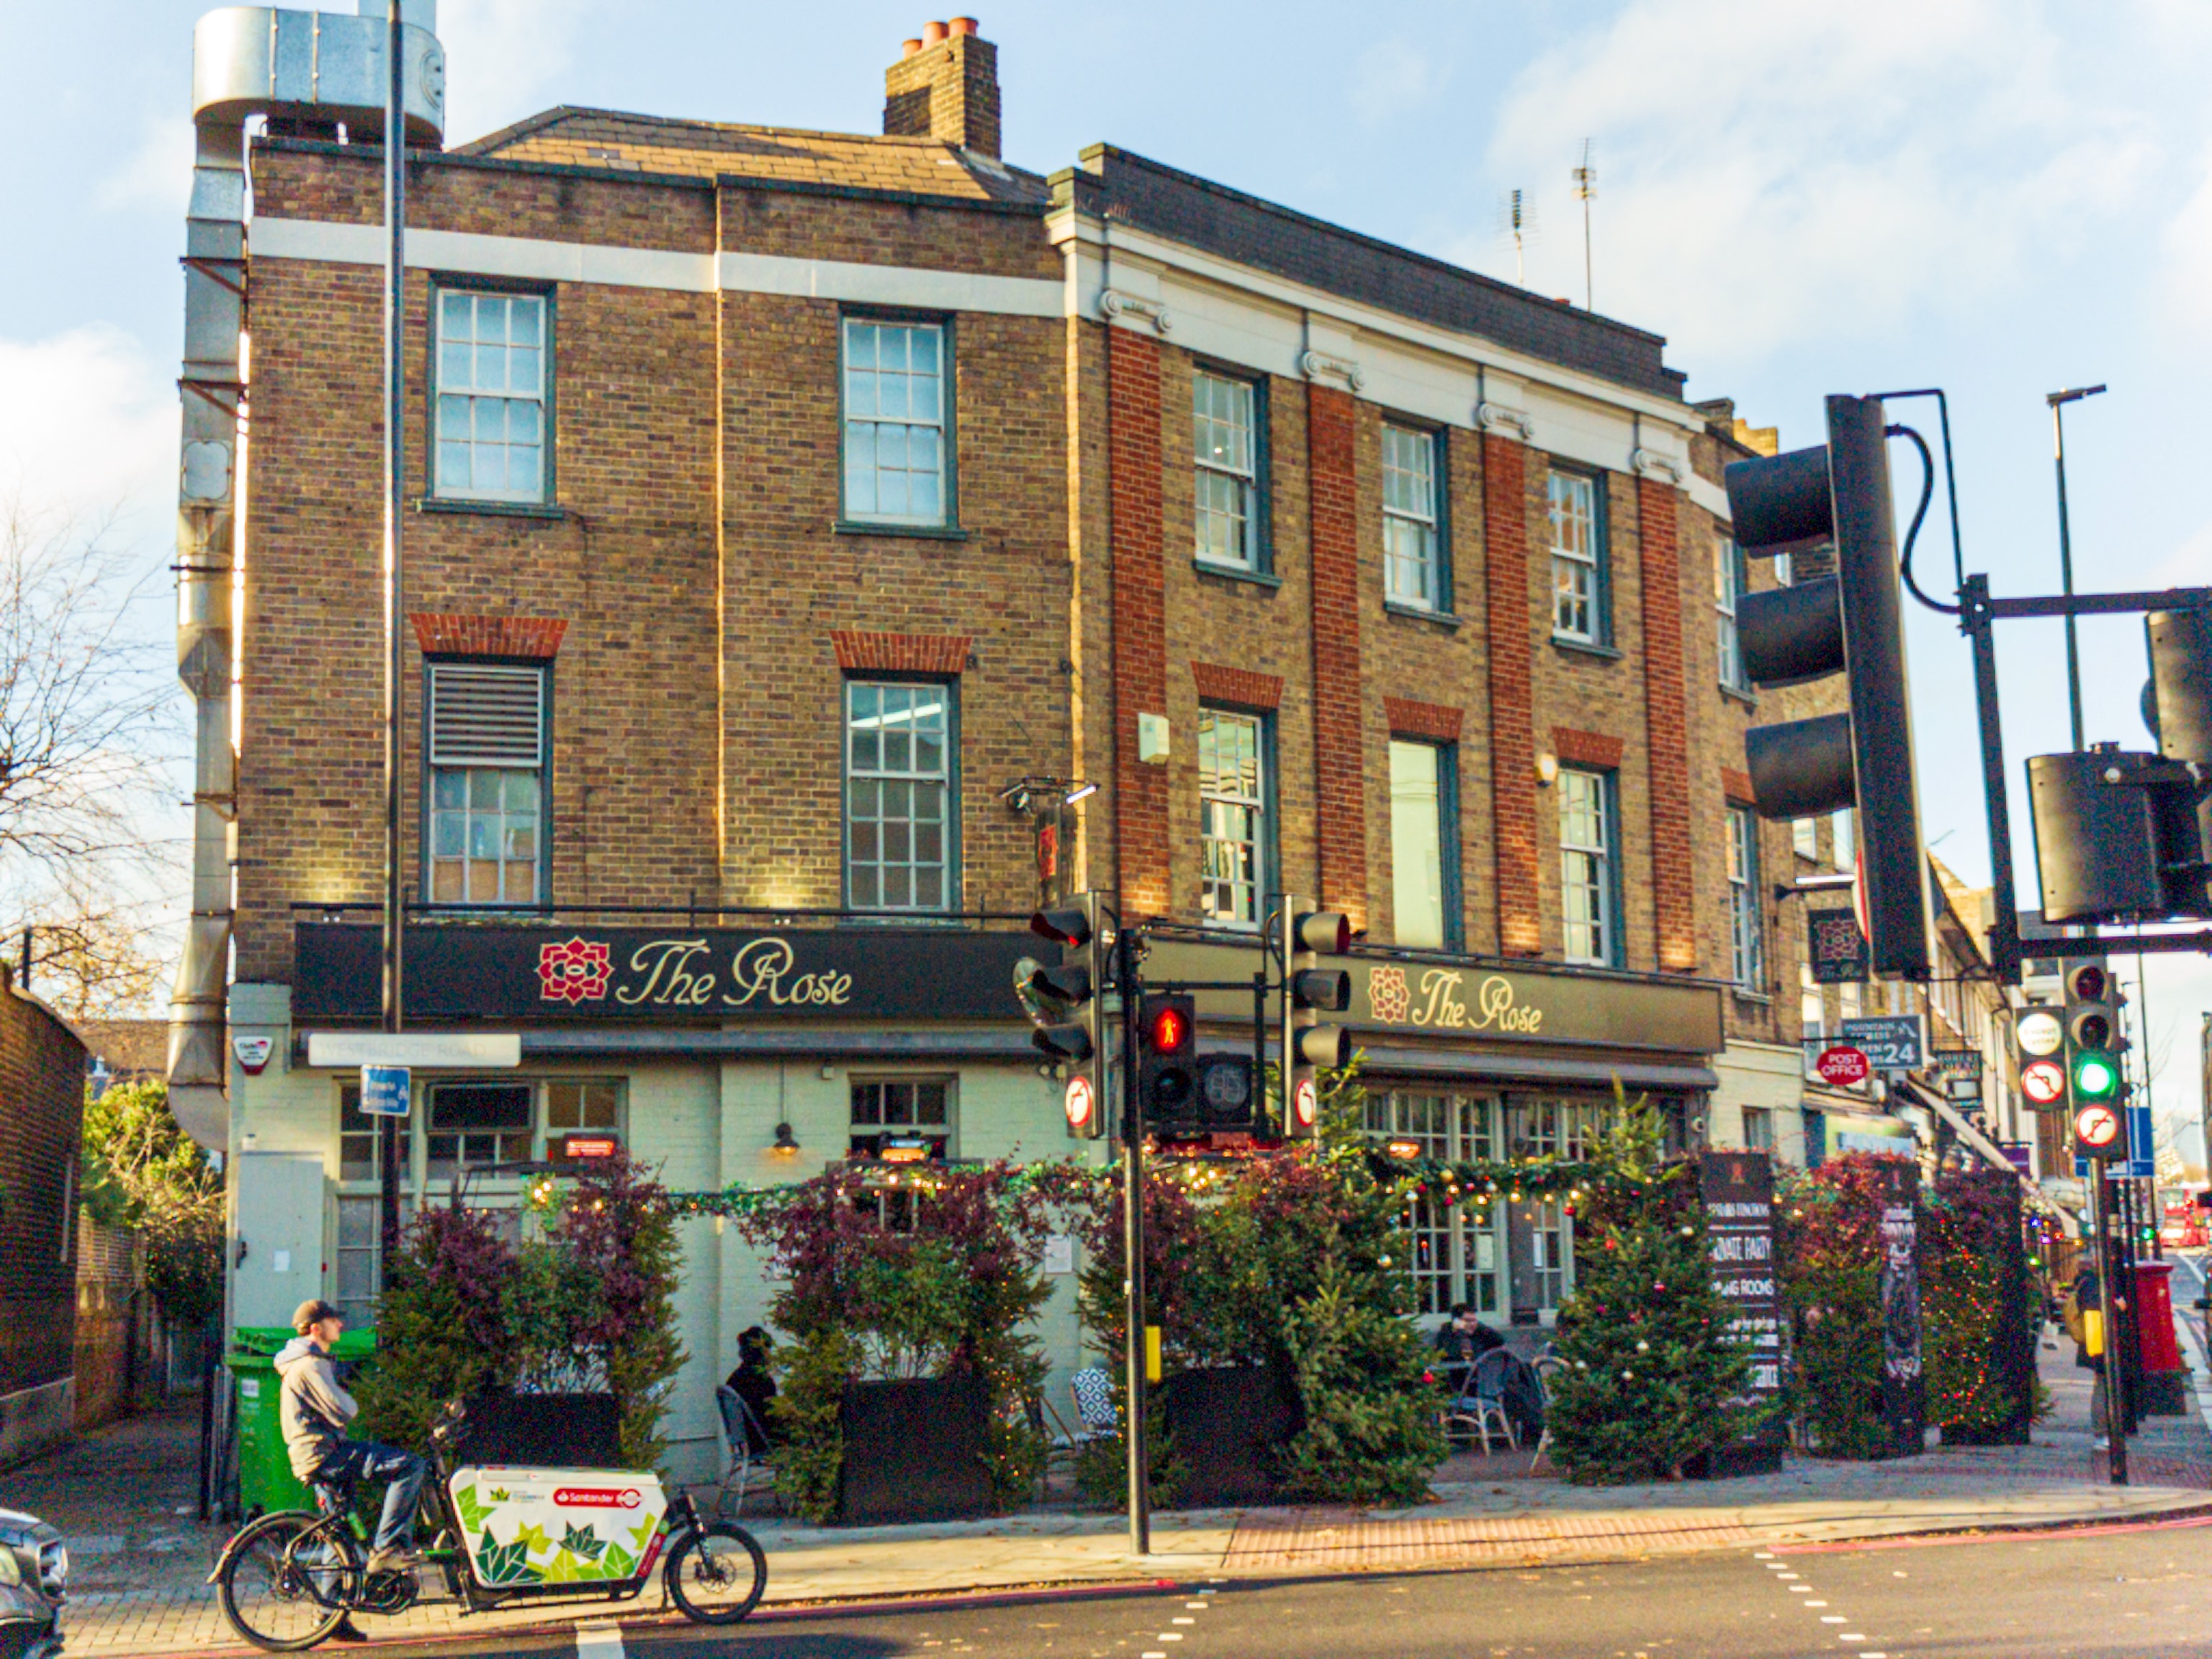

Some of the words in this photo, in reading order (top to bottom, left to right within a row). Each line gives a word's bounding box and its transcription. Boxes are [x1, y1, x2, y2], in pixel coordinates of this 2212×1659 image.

[615, 938, 716, 1005] The
[722, 936, 853, 1005] Rose
[1412, 968, 1465, 1028] The
[1468, 975, 1542, 1033] Rose
[322, 1043, 431, 1057] WESTBRIDGE
[438, 1043, 486, 1057] ROAD
[1883, 1042, 1915, 1064] 24
[1828, 1053, 1858, 1064] POST
[1821, 1065, 1863, 1076] OFFICE
[570, 1491, 613, 1503] Santander
